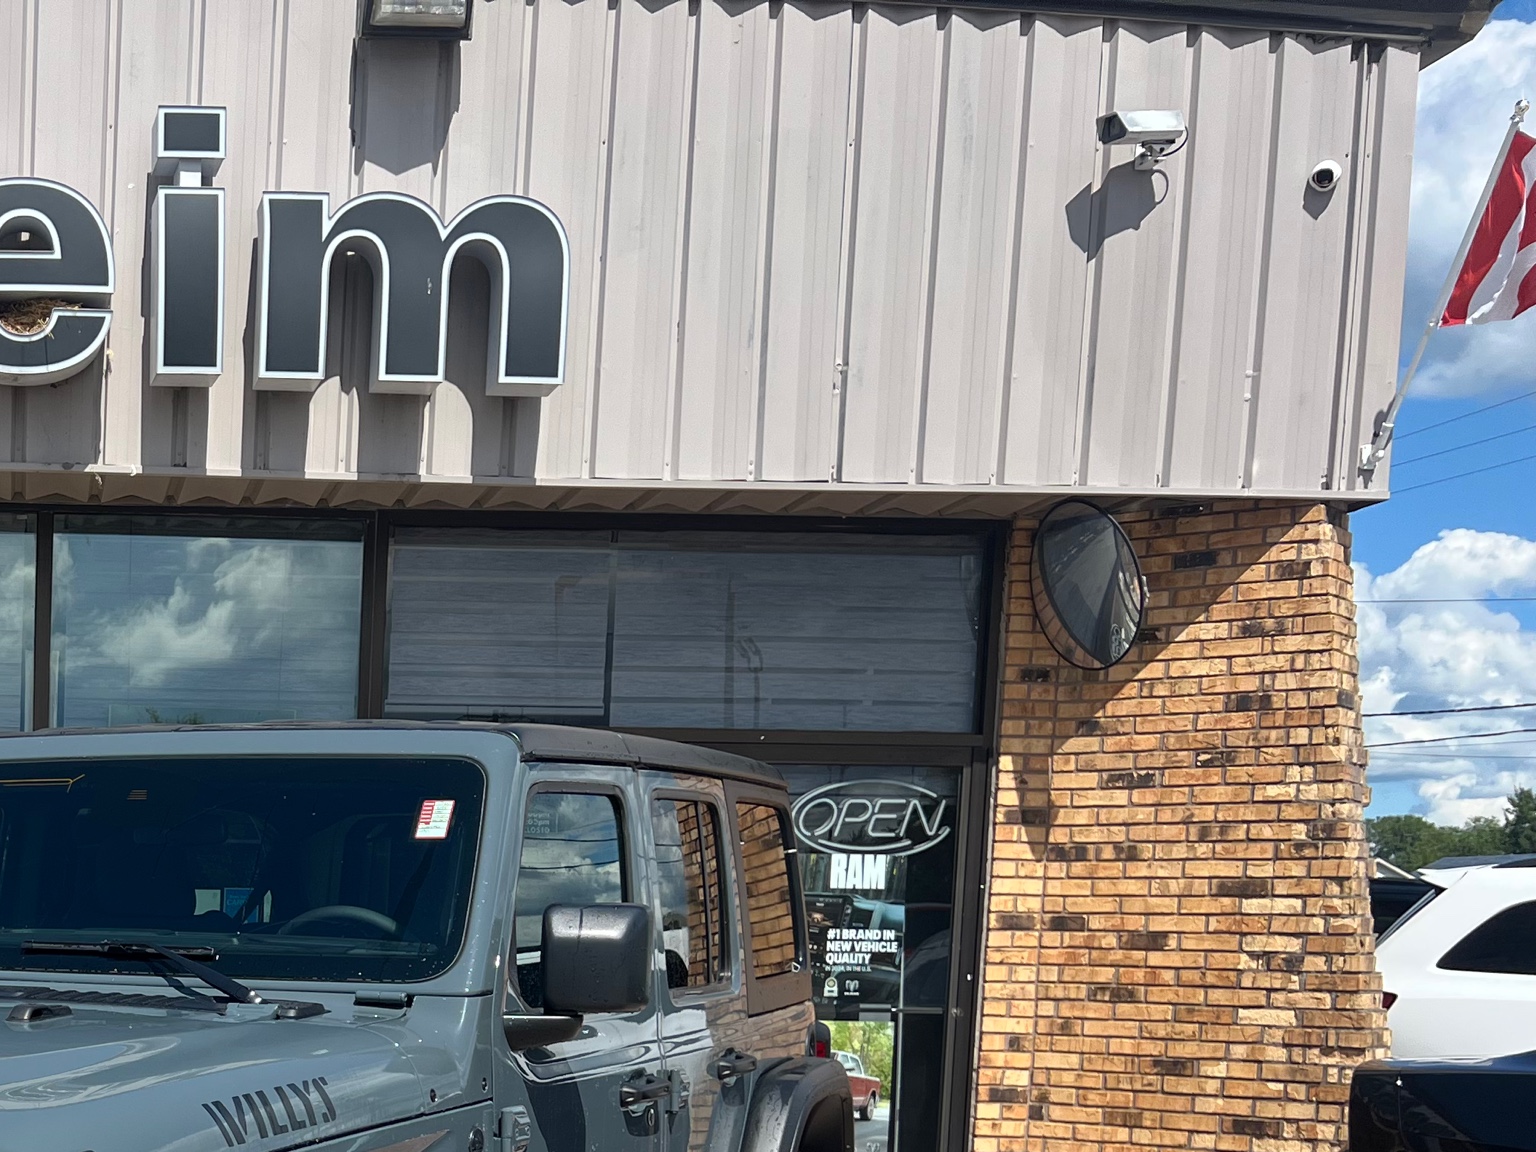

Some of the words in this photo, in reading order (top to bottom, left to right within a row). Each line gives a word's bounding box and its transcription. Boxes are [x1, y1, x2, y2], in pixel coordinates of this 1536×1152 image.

[799, 798, 946, 837] OPEN
[830, 854, 886, 889] RAM
[827, 928, 840, 940] #1
[842, 929, 881, 940] BRAND
[882, 929, 895, 940] IN
[826, 941, 852, 952] NEW
[854, 941, 898, 953] VEHICLE
[825, 953, 872, 965] QUALITY
[201, 1076, 337, 1147] WILLYS
